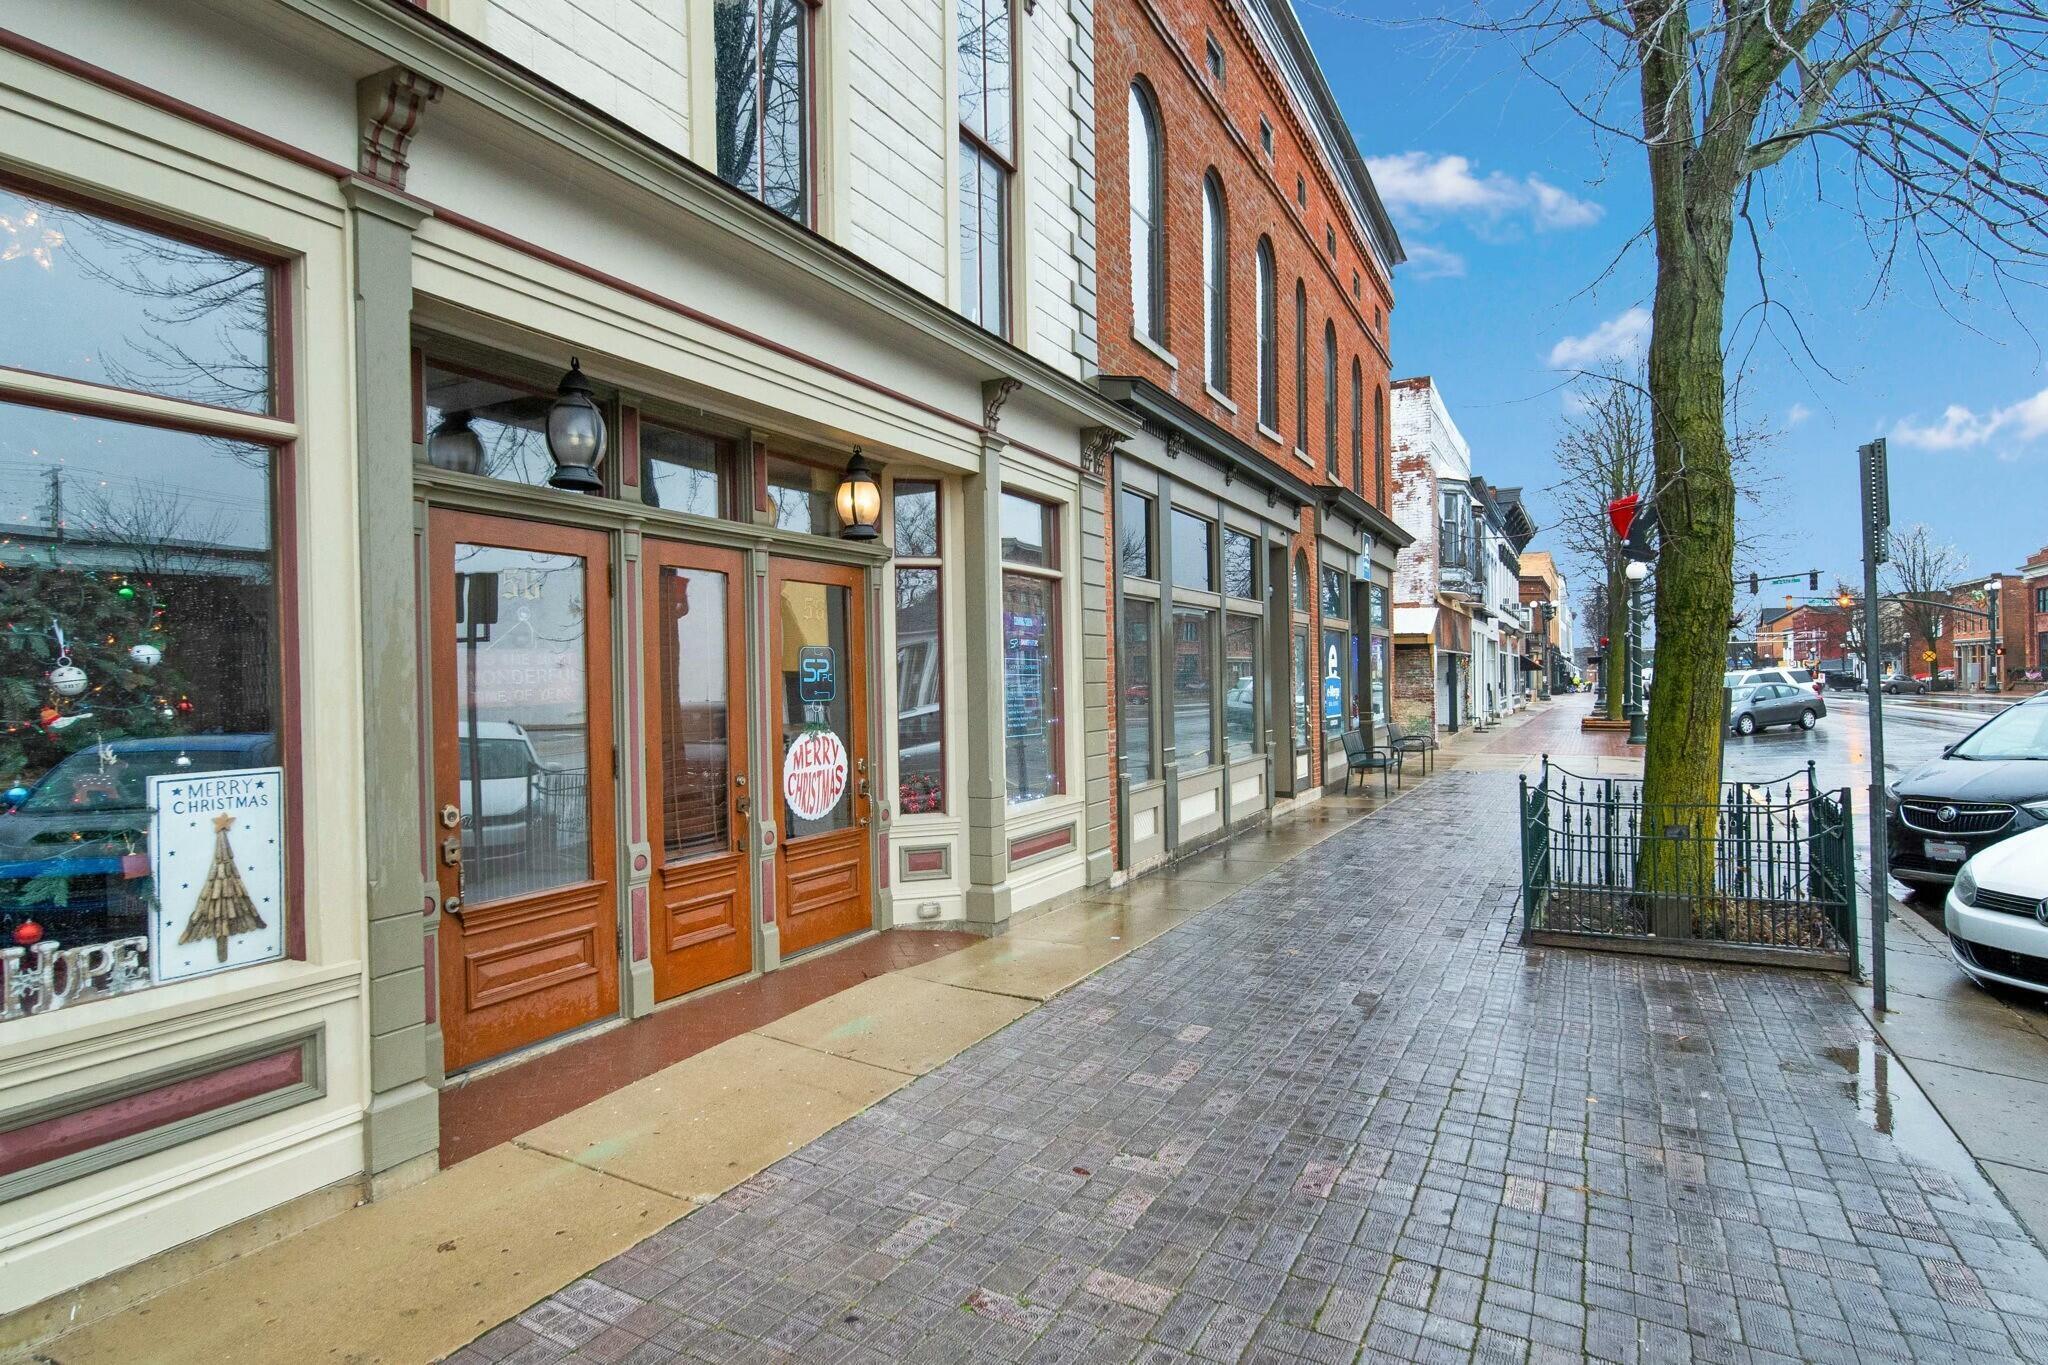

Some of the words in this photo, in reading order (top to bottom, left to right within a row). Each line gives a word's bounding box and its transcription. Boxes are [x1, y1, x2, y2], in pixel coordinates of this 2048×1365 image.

[793, 735, 839, 770] MERRY
[173, 794, 269, 815] CHRISTMAS
[188, 778, 255, 798] MERRY
[787, 764, 844, 816] CHRISTMAS
[0, 936, 150, 1019] HOPE
